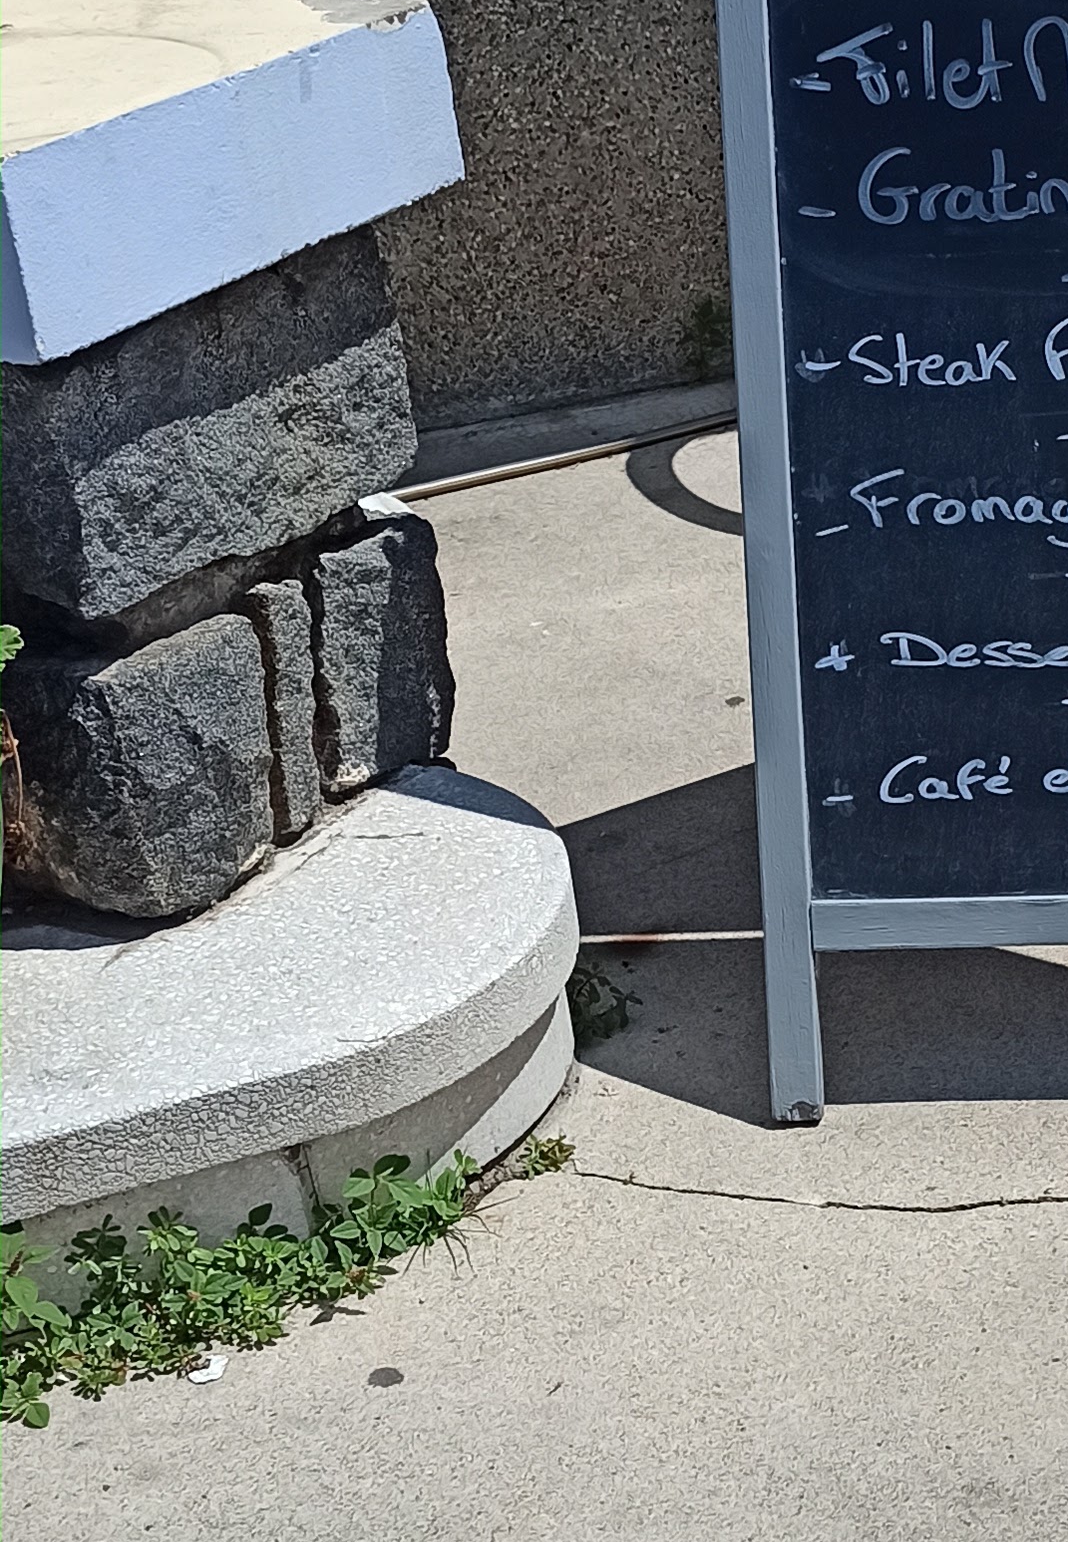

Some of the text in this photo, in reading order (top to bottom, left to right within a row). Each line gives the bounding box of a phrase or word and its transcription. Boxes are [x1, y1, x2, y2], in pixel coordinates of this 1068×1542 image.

[816, 21, 1014, 109] Filet
[846, 332, 1018, 387] Steak
[879, 754, 1015, 805] Café
